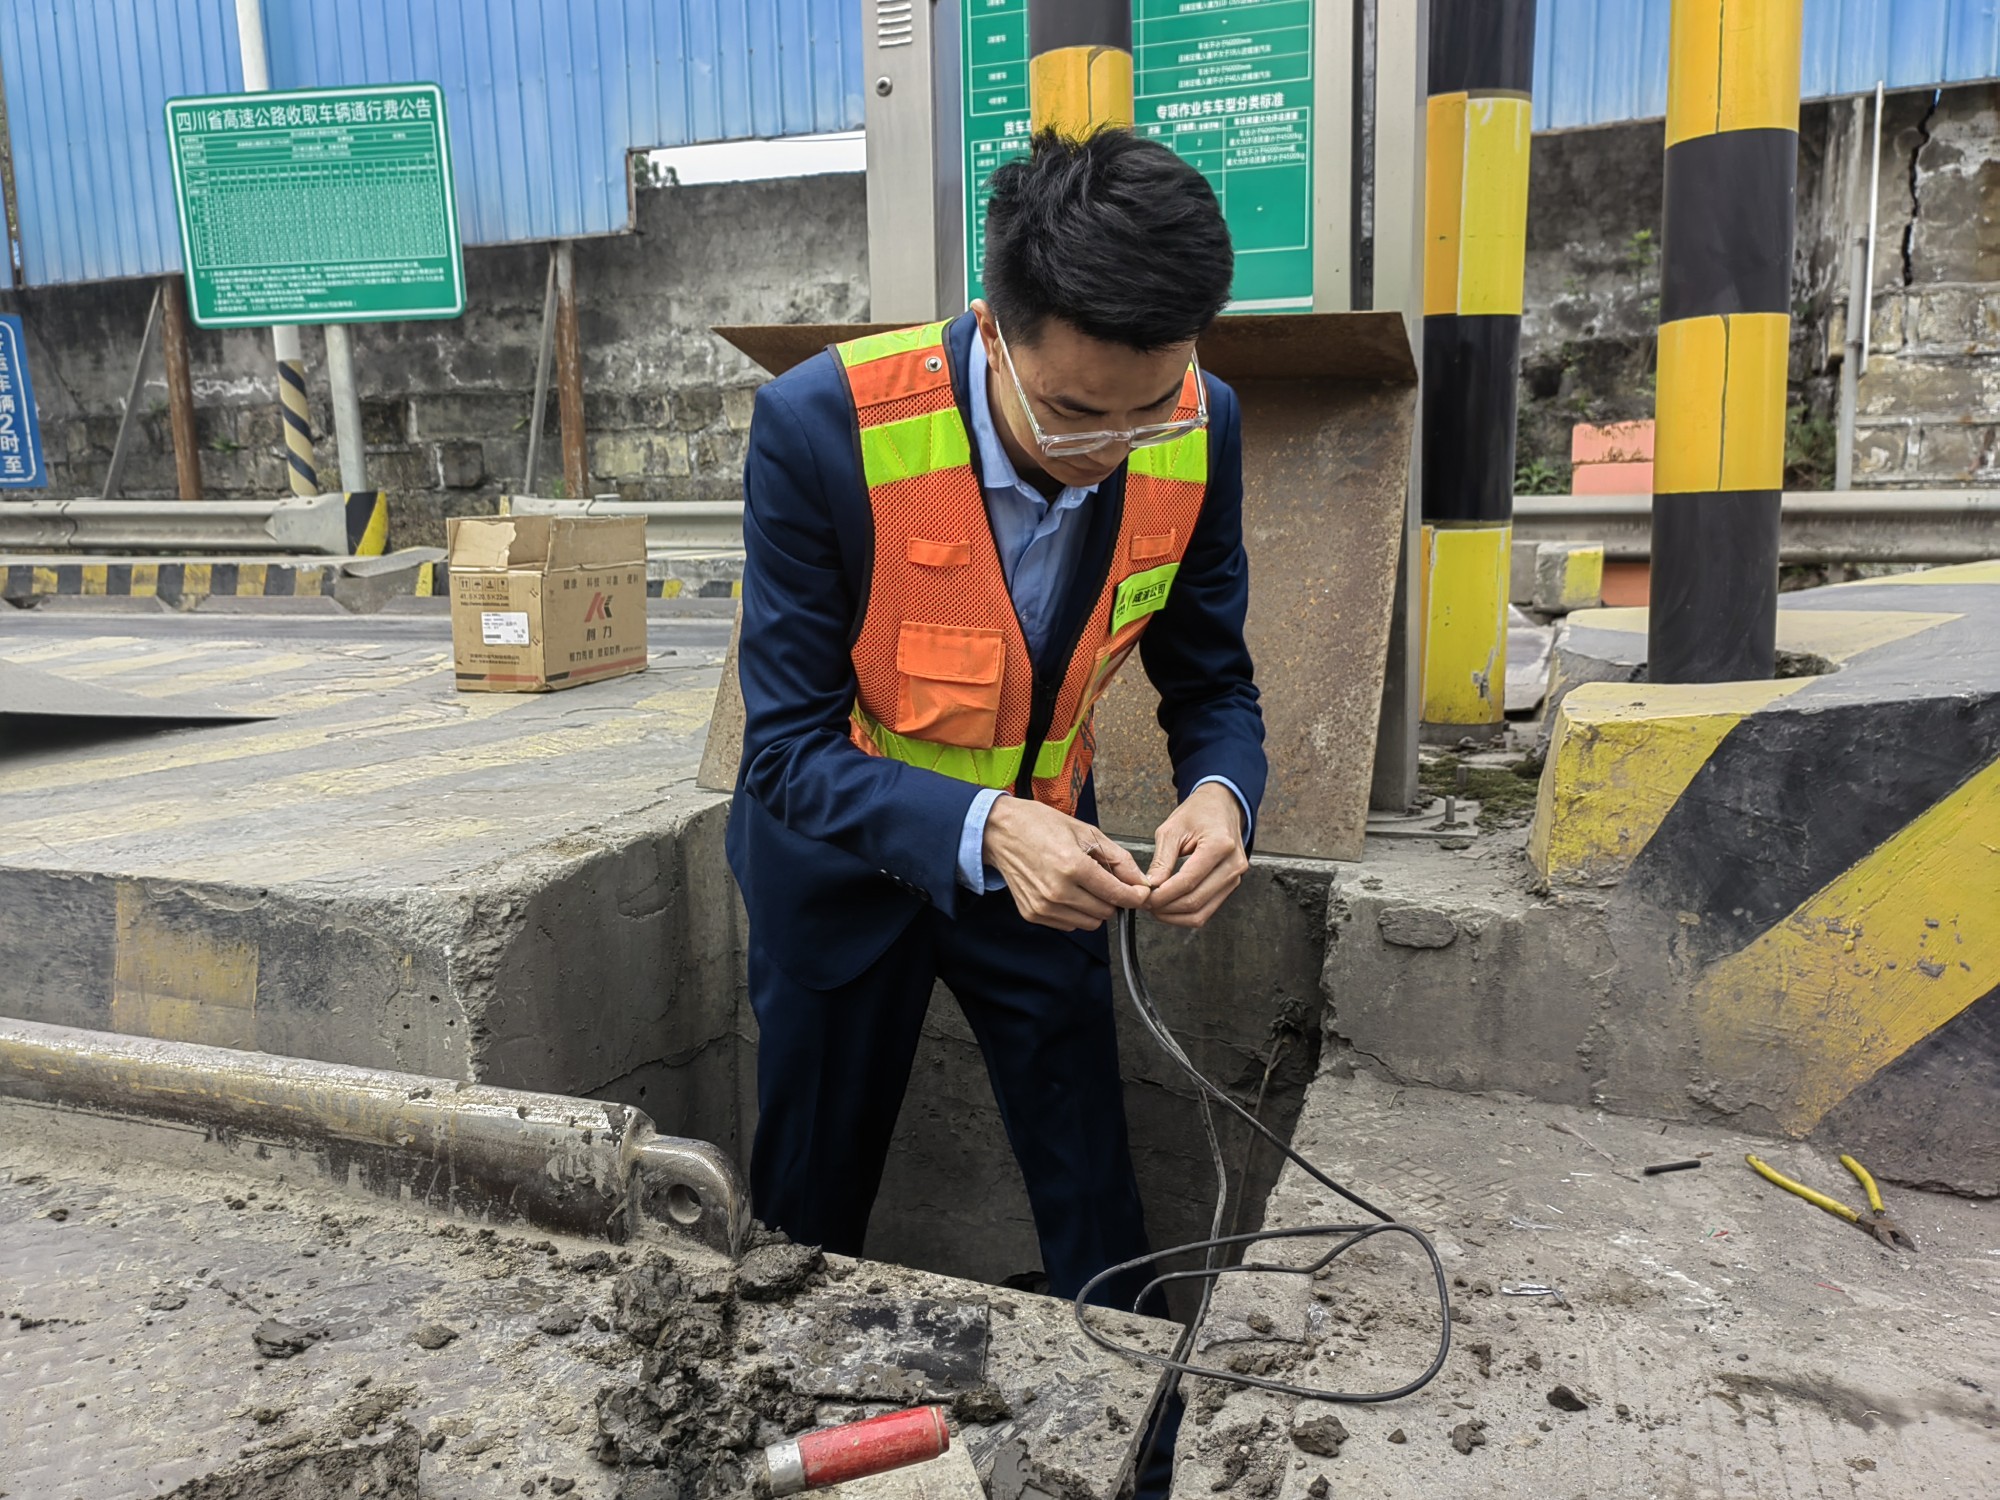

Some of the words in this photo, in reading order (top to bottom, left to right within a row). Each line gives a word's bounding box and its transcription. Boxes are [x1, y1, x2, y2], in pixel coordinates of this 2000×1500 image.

[176, 97, 432, 133] 四川省高速公路收取车辆通行费公告
[1156, 92, 1285, 119] 专项作业车车型分类标准
